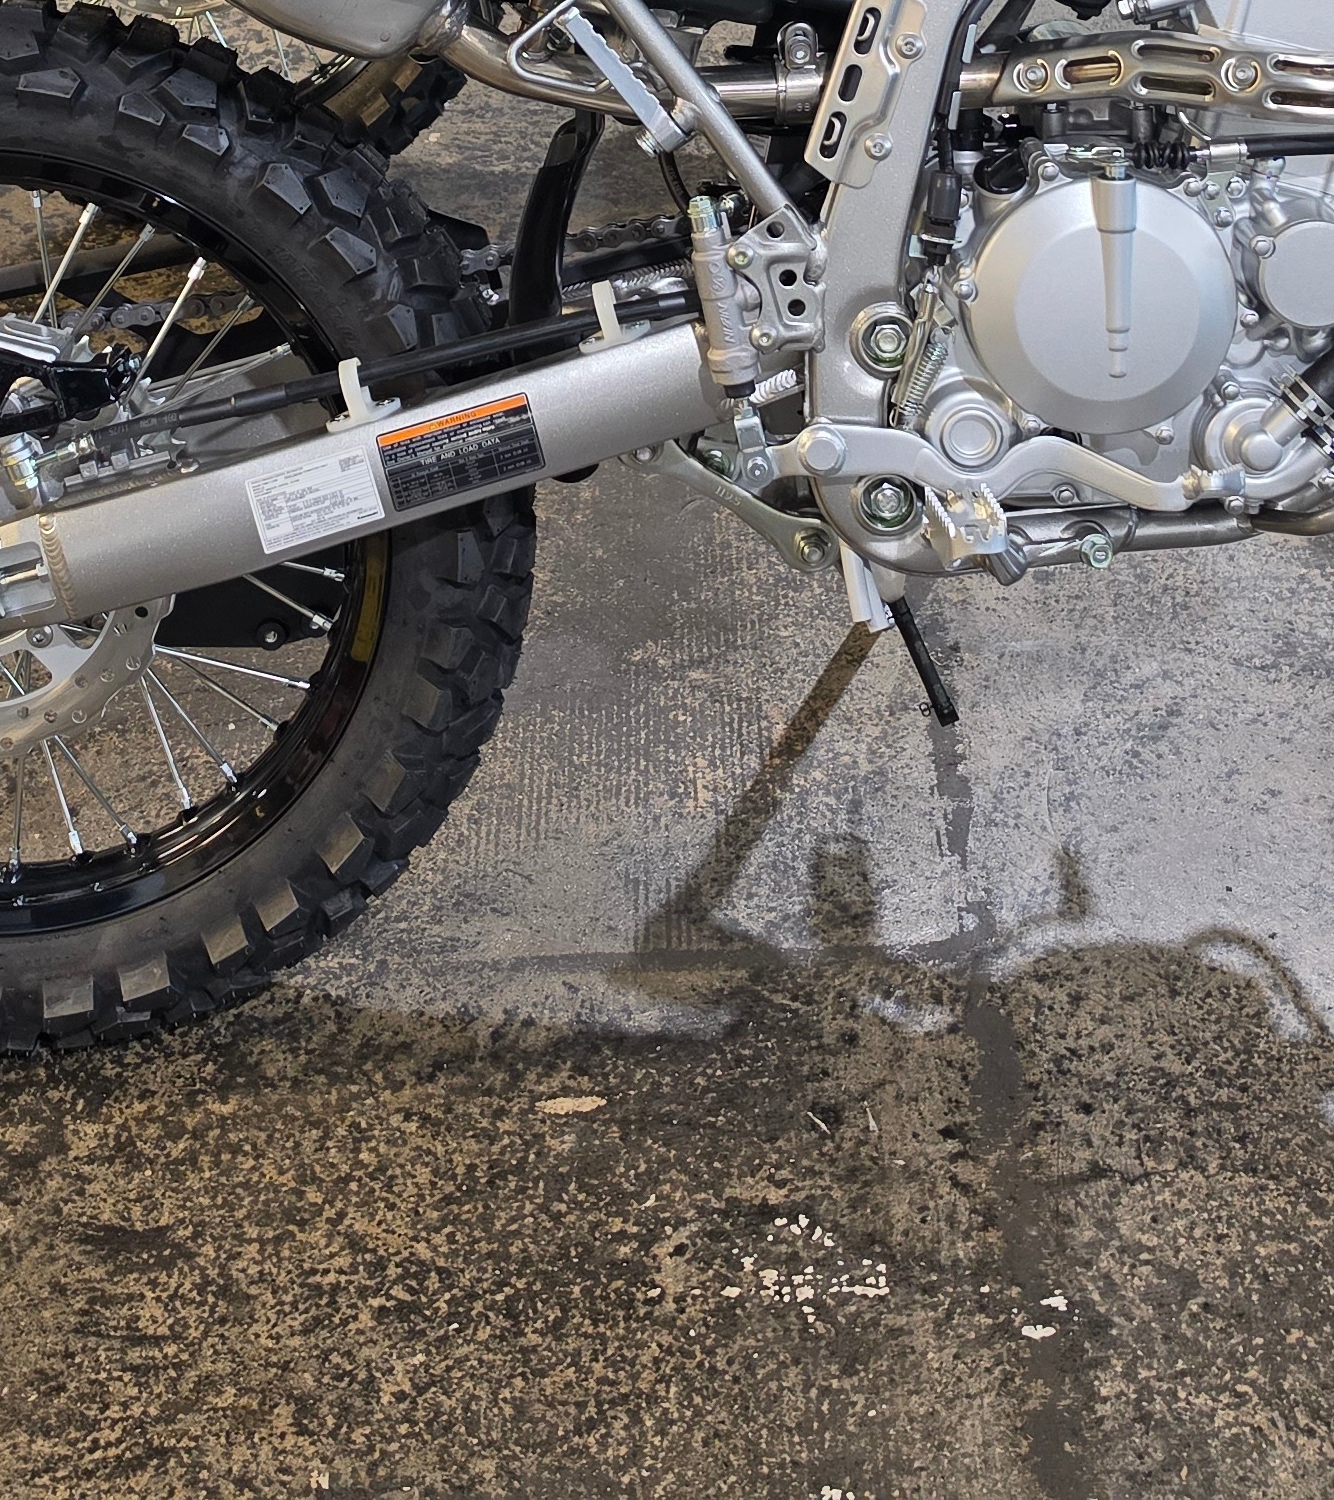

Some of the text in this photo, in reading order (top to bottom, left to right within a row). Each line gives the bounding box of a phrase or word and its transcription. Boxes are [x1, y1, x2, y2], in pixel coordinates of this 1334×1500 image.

[436, 410, 477, 427] WARNING
[420, 438, 501, 466] TIRE AND LOAD DATA
